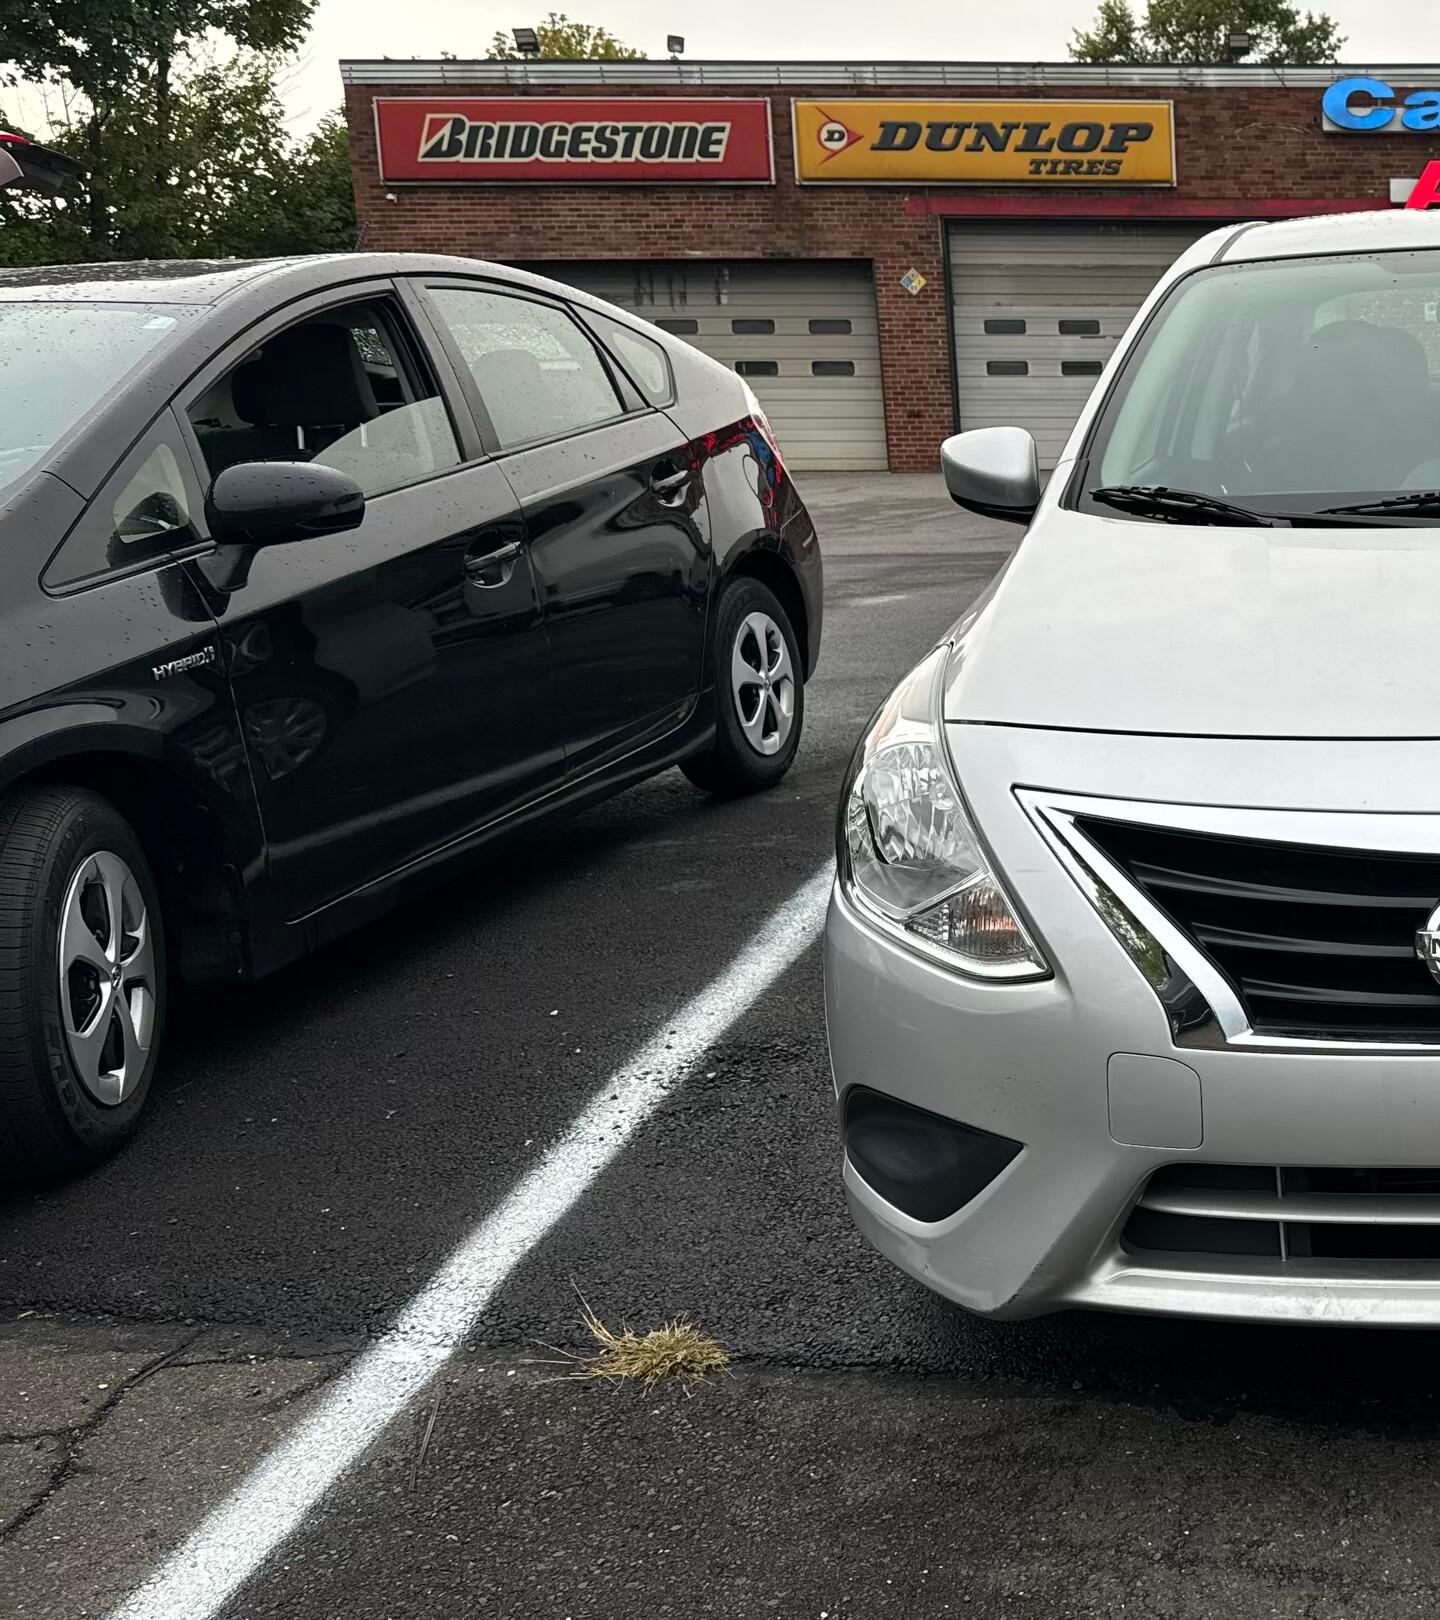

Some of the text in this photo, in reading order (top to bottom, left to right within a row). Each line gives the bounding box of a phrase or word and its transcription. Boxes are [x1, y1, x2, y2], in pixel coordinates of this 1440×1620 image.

[418, 113, 730, 162] BRIDGESTONE
[870, 121, 1154, 152] DUNLOP
[1029, 158, 1124, 175] TIRES
